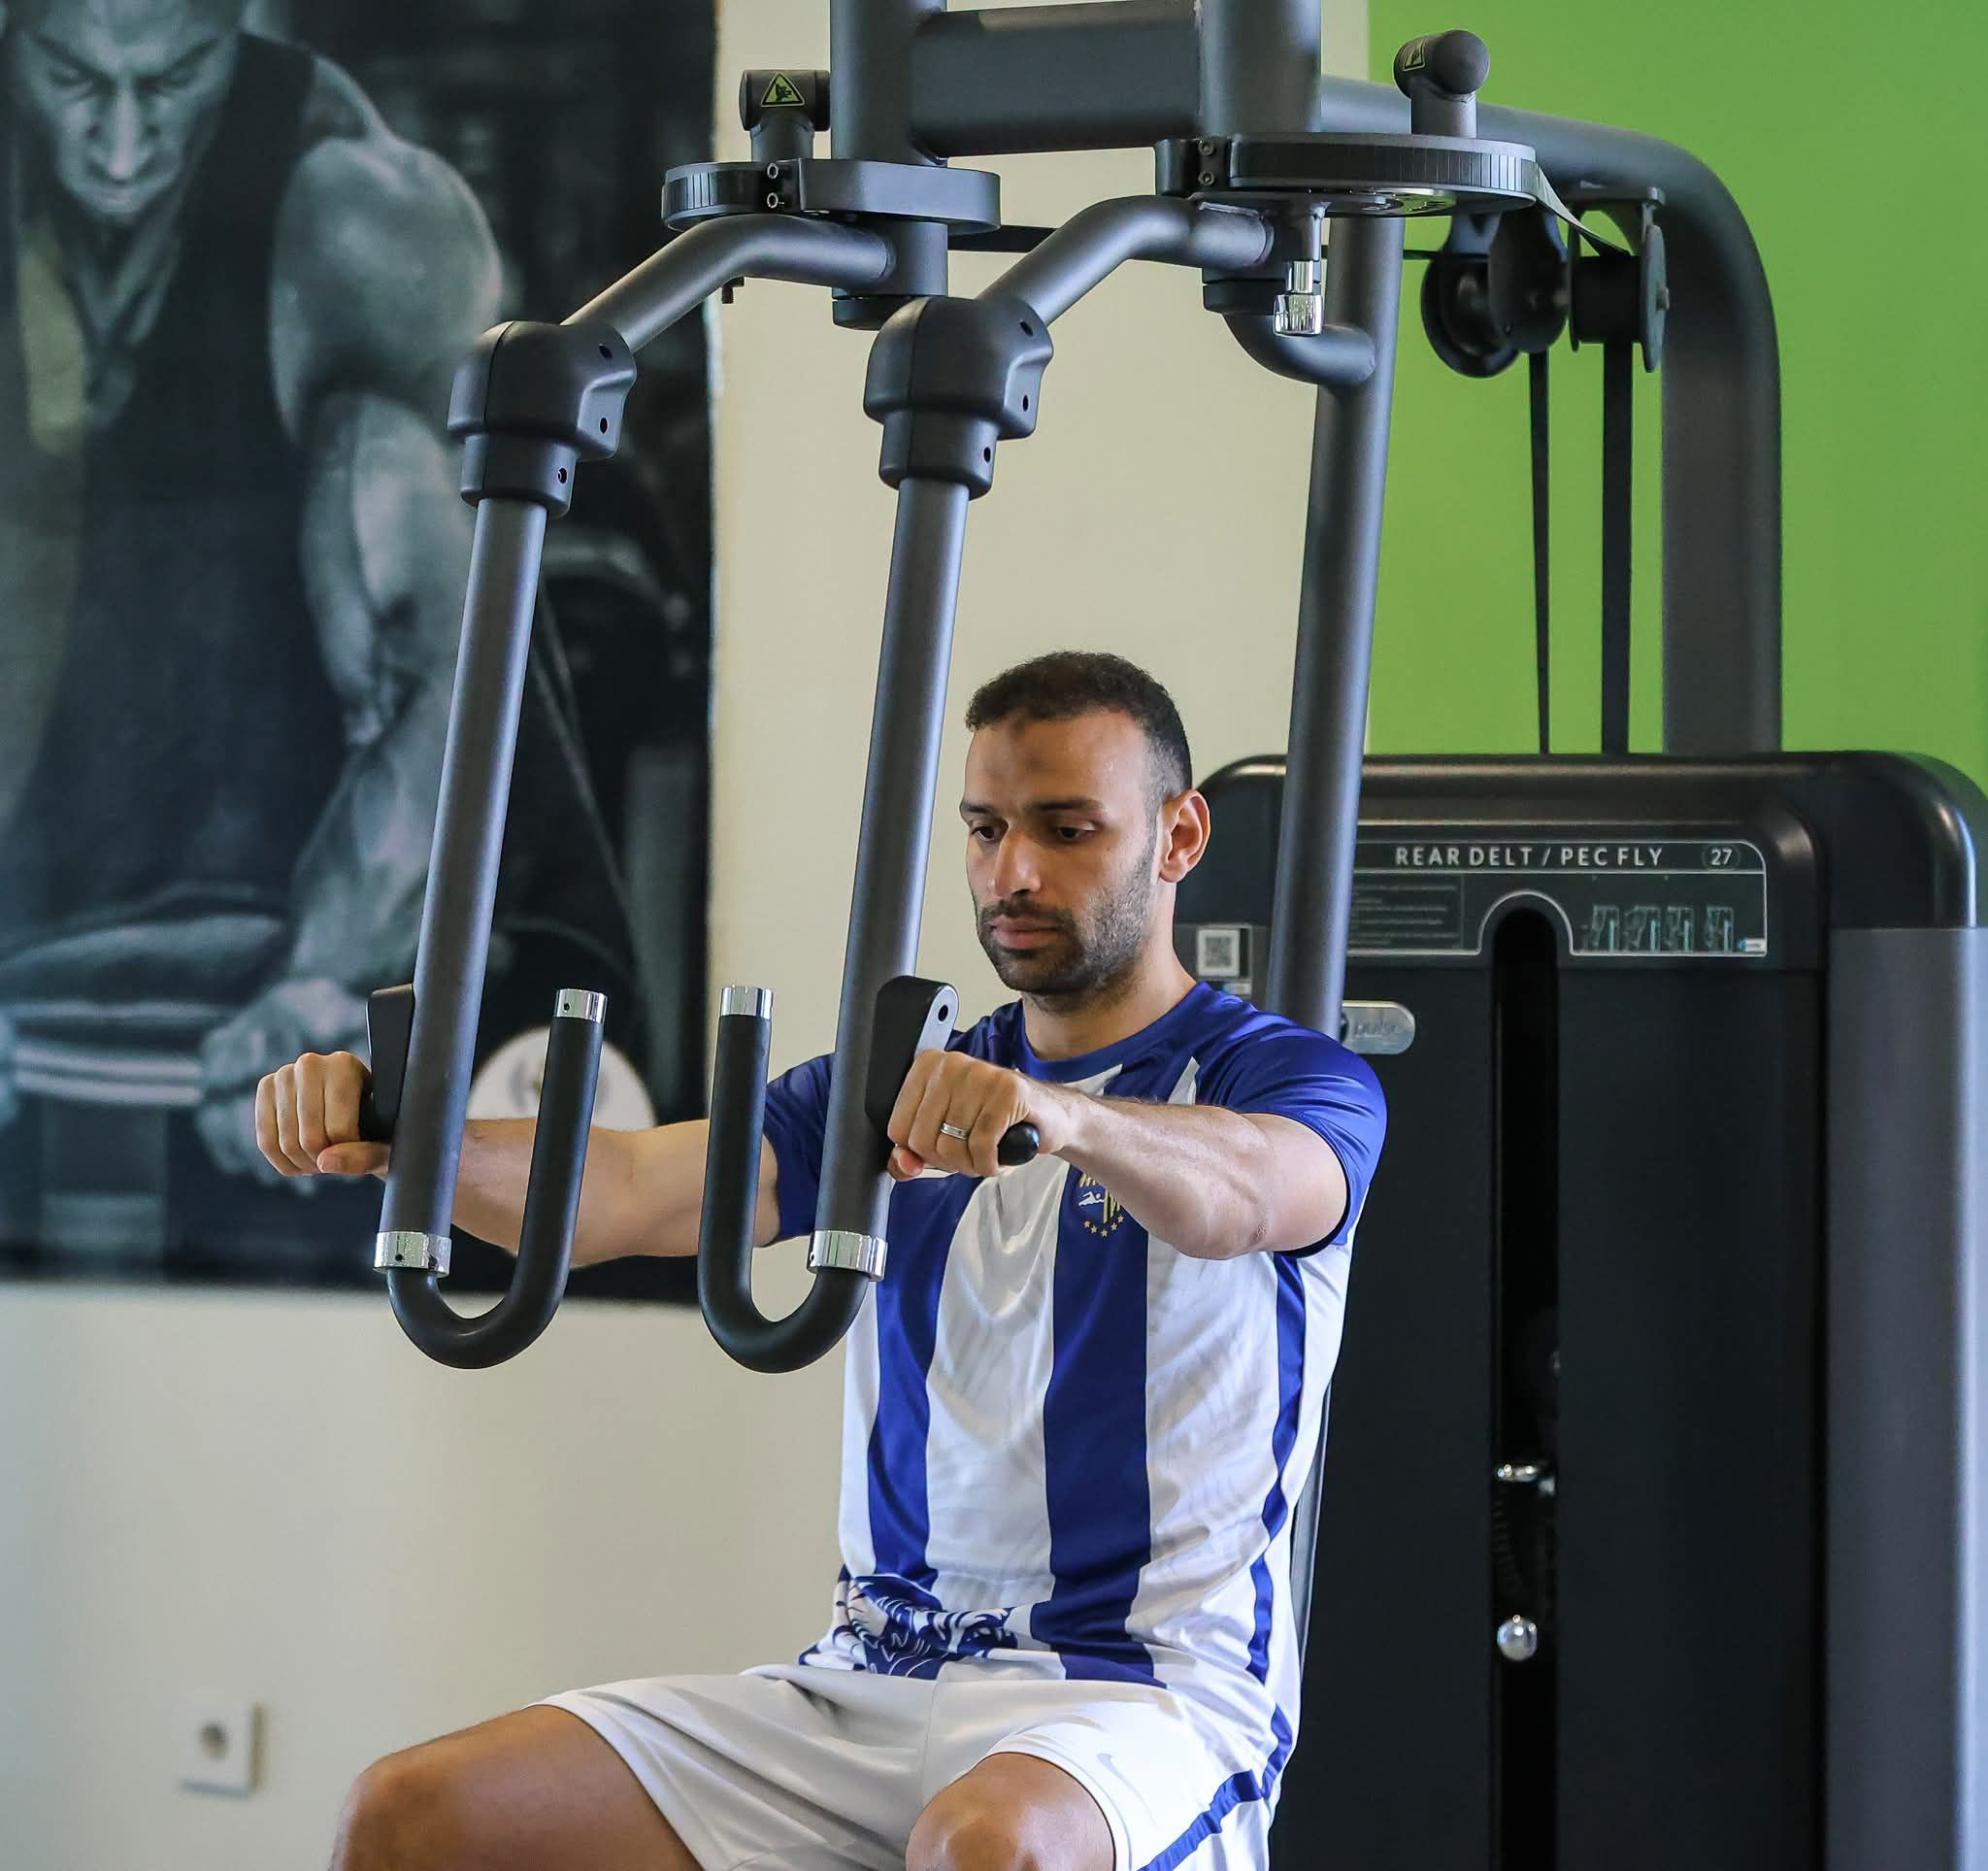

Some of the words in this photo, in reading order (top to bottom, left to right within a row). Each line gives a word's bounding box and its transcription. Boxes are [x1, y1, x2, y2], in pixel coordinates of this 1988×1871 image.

[1395, 847, 1460, 866] REAR
[1469, 847, 1533, 866] DELT
[1541, 847, 1551, 867] /
[1561, 847, 1607, 866] PEC
[1617, 847, 1663, 866] FLY
[1710, 849, 1733, 866] 27
